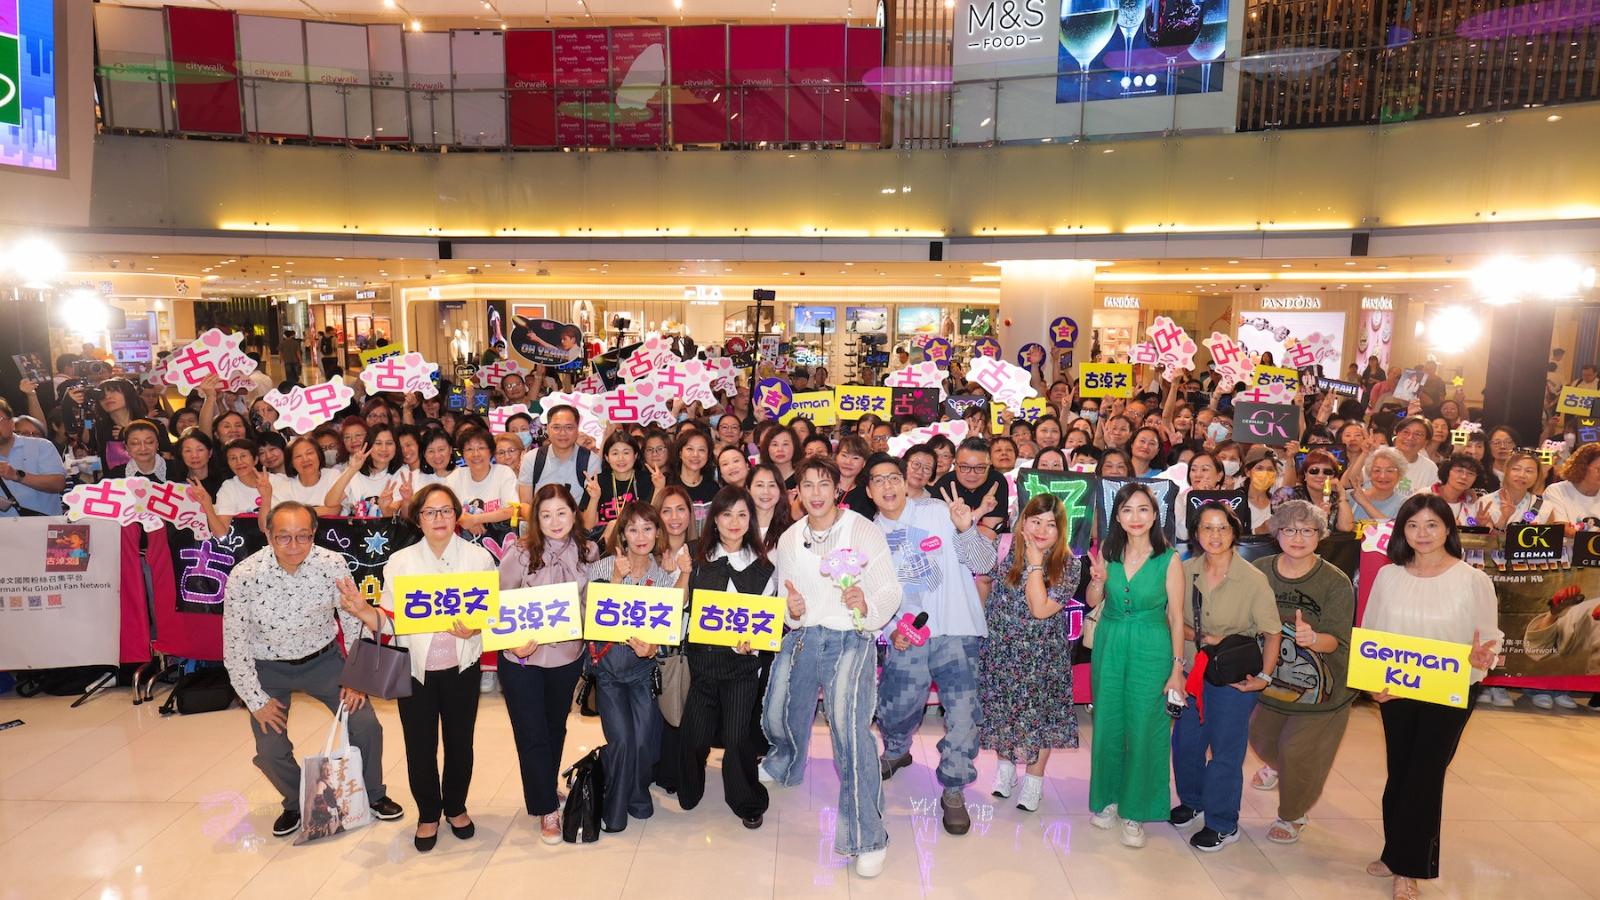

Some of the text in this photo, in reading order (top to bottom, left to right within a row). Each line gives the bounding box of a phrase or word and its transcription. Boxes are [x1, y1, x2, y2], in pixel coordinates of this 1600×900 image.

[967, 0, 1045, 34] M&S
[983, 34, 1028, 49] FOOD
[185, 62, 225, 73] citywalk
[254, 67, 293, 79] citywalk
[320, 74, 359, 85] citywalk
[514, 79, 548, 90] citywalk
[1261, 296, 1321, 309] PANDORA
[1153, 322, 1182, 354] 古
[218, 352, 247, 377] Ger
[626, 351, 653, 378] 古
[1211, 340, 1241, 365] 古
[1289, 343, 1316, 368] 古
[176, 347, 218, 385] 古
[375, 359, 406, 390] 古
[976, 359, 1012, 393] 古
[406, 375, 432, 393] Ger
[685, 384, 711, 404] Ger
[605, 389, 639, 421] 古
[641, 404, 669, 425] Ger
[789, 399, 830, 411] erman
[895, 393, 915, 416] 古
[1249, 410, 1291, 439] GK
[83, 481, 126, 518] 古
[146, 482, 185, 520] 古
[178, 511, 206, 531] Ger
[1517, 526, 1551, 548] GK
[179, 540, 235, 605] 古
[404, 587, 490, 619] 古淖文
[594, 598, 674, 629] 古淖文
[699, 604, 776, 635] 古淖文
[1360, 640, 1460, 674] German
[1384, 666, 1421, 690] Ku
